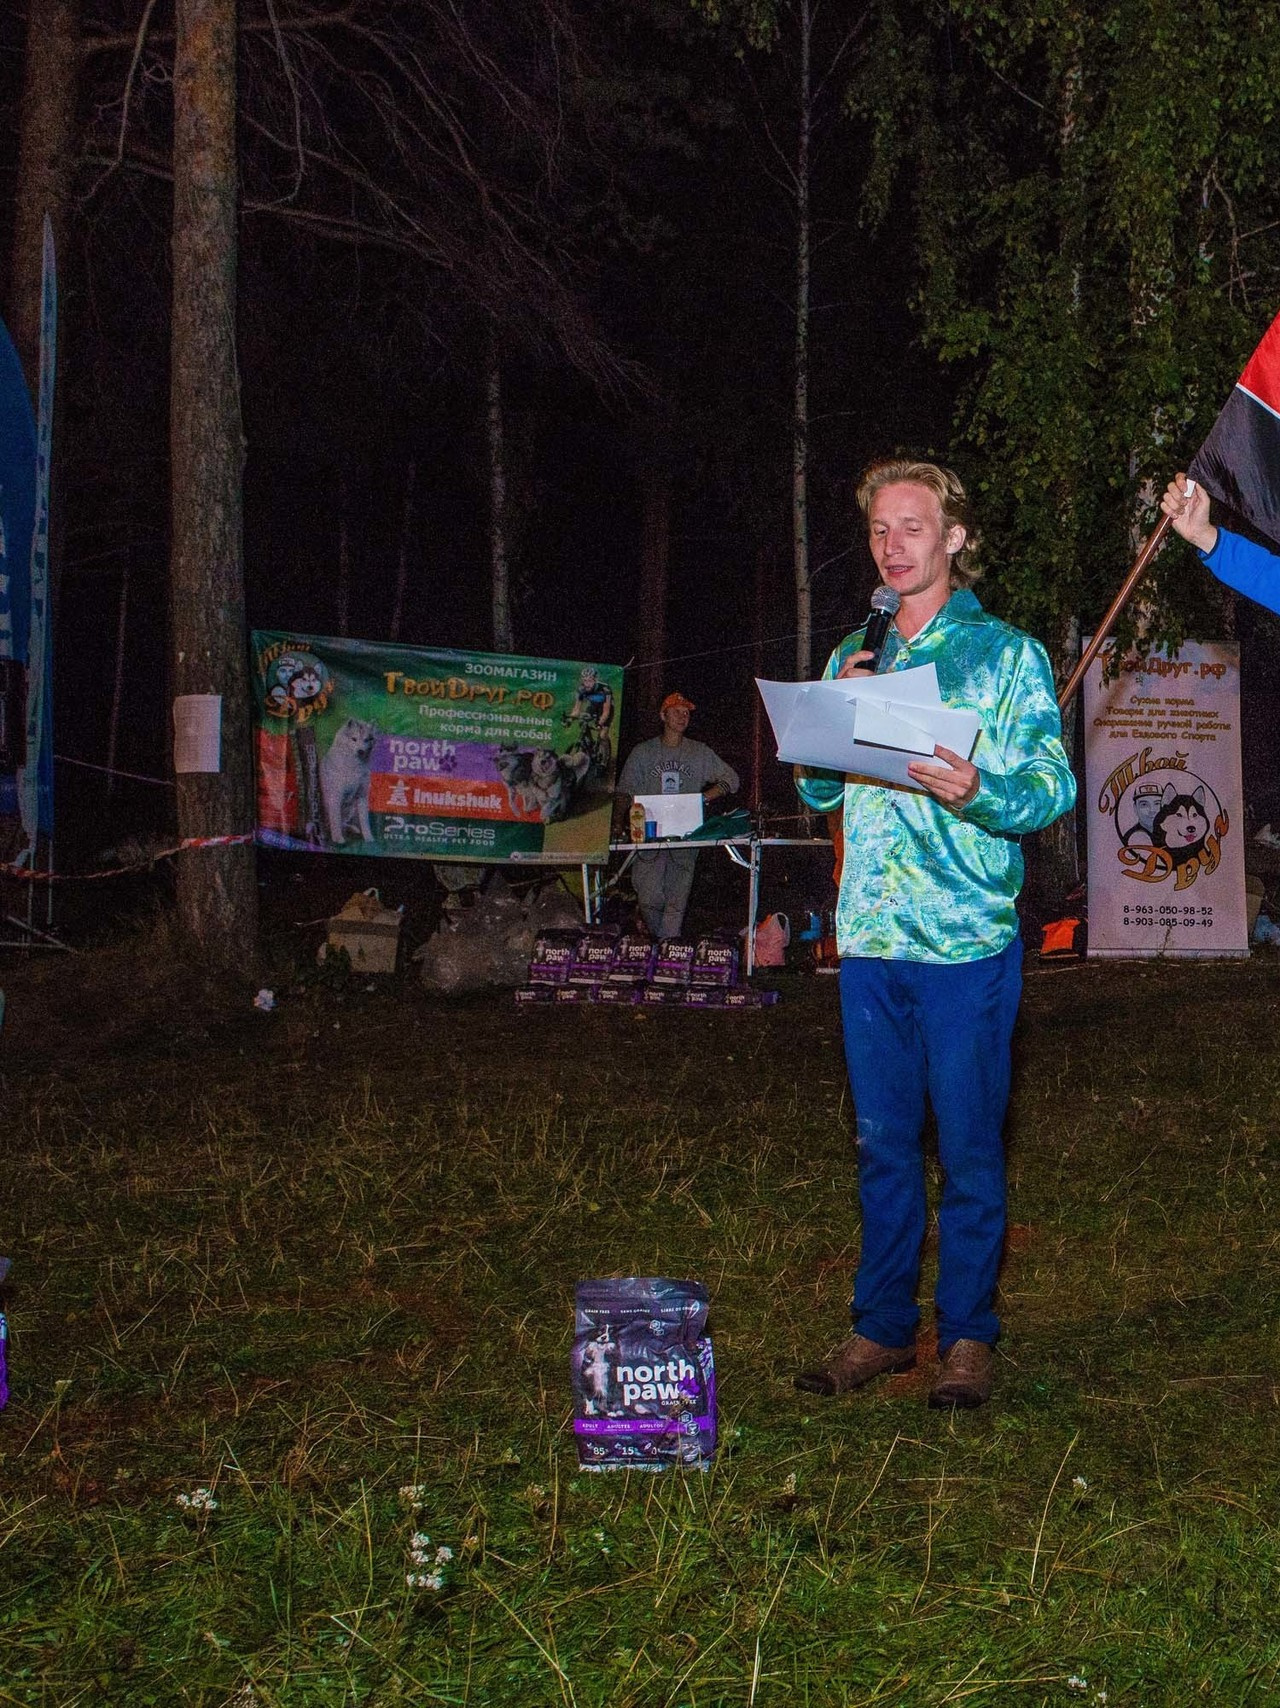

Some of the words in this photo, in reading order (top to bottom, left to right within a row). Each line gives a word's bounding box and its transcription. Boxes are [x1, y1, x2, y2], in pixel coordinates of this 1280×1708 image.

[465, 663, 558, 682] ЗООМАГАЗИН
[419, 705, 553, 727] Профессиональные
[440, 723, 482, 735] корма
[485, 727, 510, 737] для
[513, 728, 552, 740] собак
[390, 739, 456, 757] north
[394, 755, 440, 773] paw
[413, 788, 503, 810] Inukshuk
[384, 816, 496, 839] ProSeries
[1123, 905, 1213, 916] 8-963-050-98-52
[1123, 917, 1213, 928] 8-903-085-09-49
[545, 948, 570, 956] north
[588, 947, 613, 955] north
[668, 944, 694, 953] north
[707, 948, 732, 956] north
[616, 1359, 695, 1383] north
[624, 1383, 680, 1406] paw
